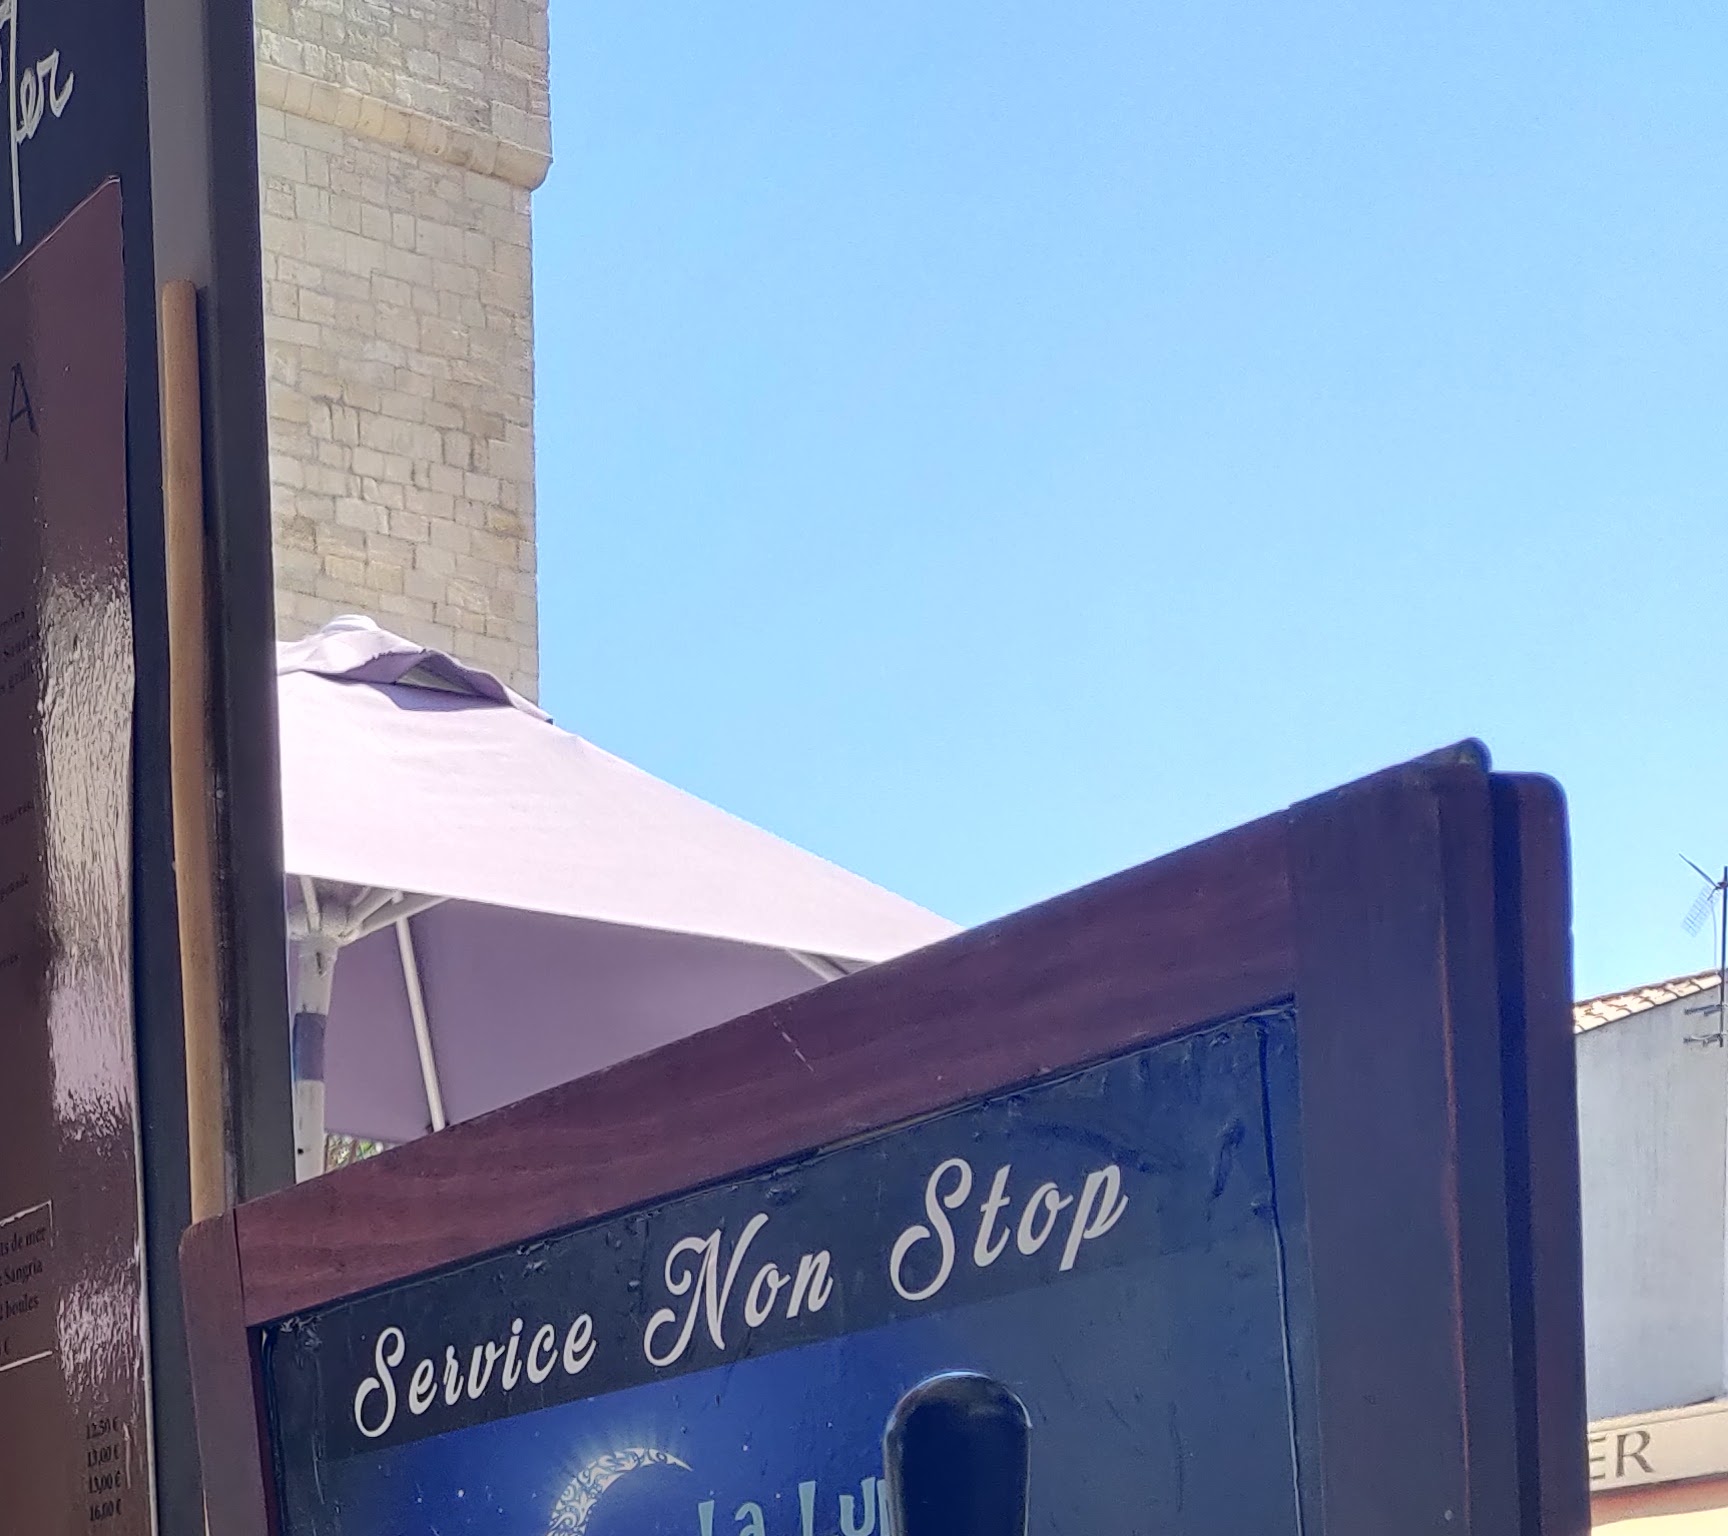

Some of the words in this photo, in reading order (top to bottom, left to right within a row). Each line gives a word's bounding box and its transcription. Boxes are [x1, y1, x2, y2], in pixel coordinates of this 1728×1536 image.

[355, 1312, 598, 1438] Service
[644, 1213, 834, 1368] Non
[890, 1157, 1130, 1302] Stop
